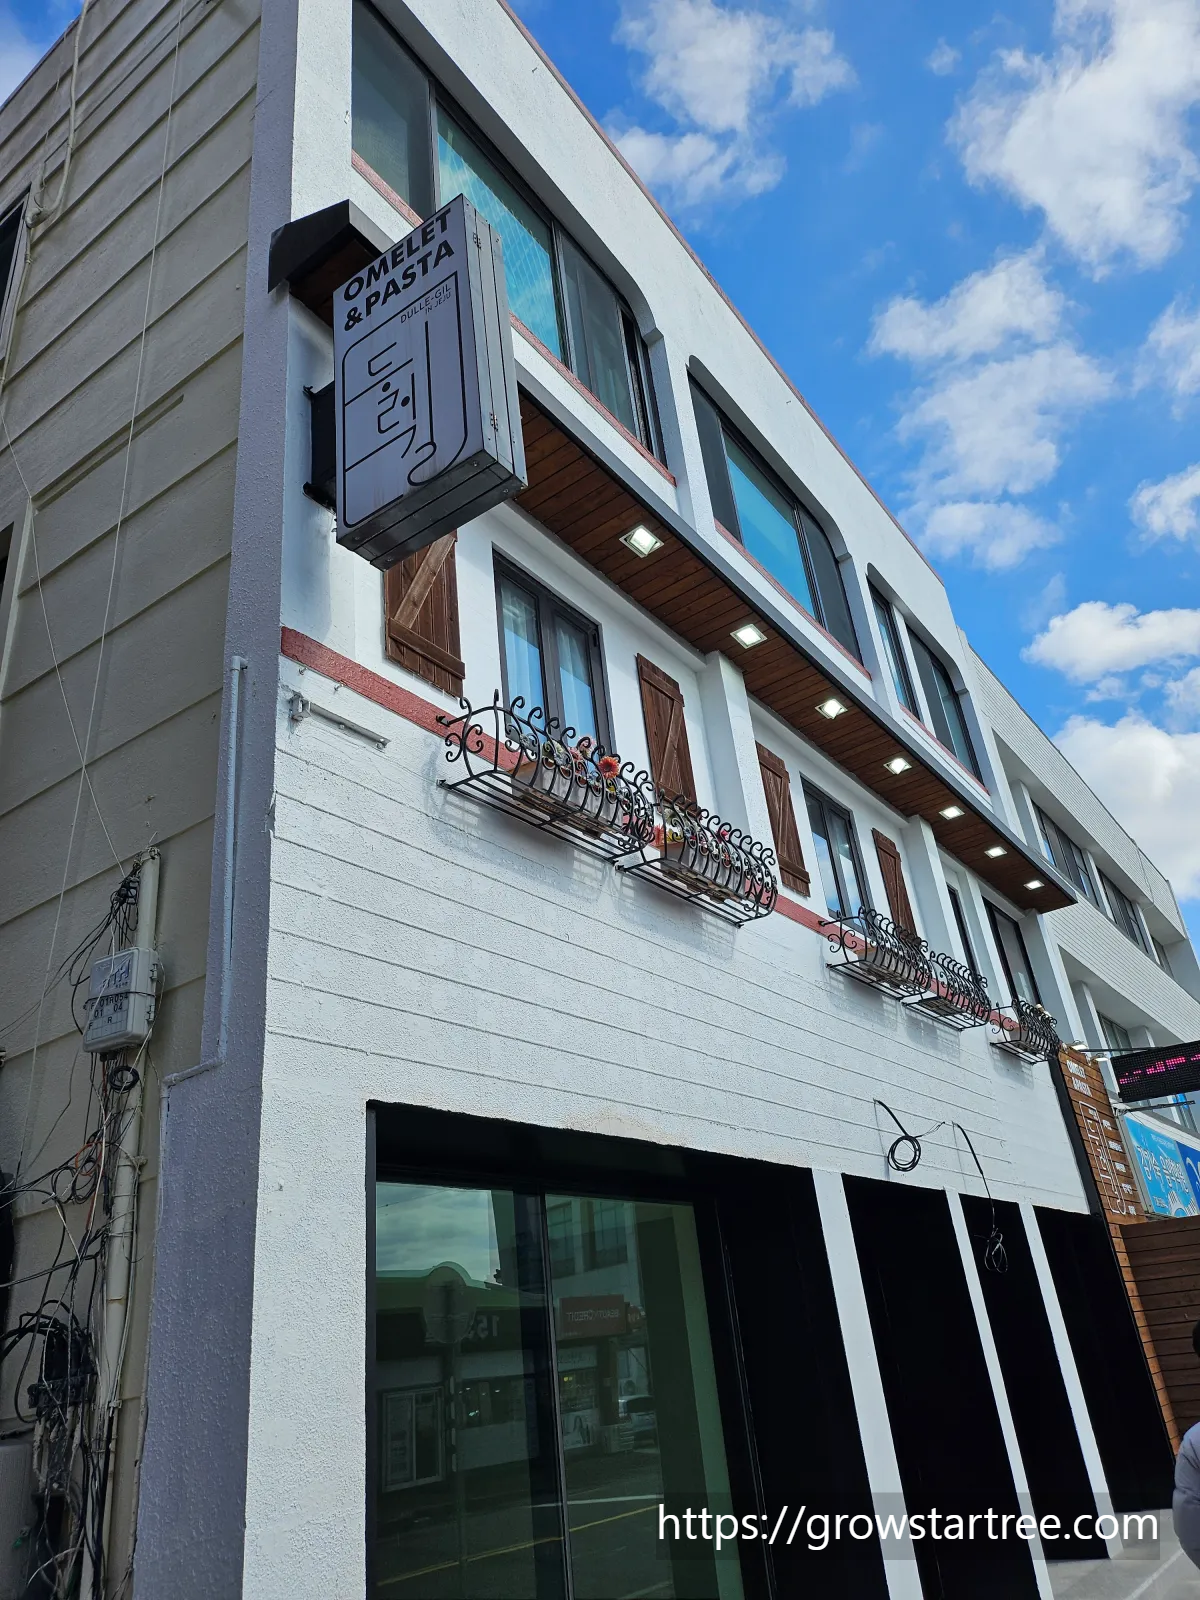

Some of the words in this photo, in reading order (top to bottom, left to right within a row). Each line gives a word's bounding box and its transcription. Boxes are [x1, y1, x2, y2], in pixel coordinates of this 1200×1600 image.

[344, 209, 451, 302] OMELET
[400, 284, 451, 324] DULLE-GIL
[425, 305, 433, 316] IN
[434, 291, 451, 308] JEJU
